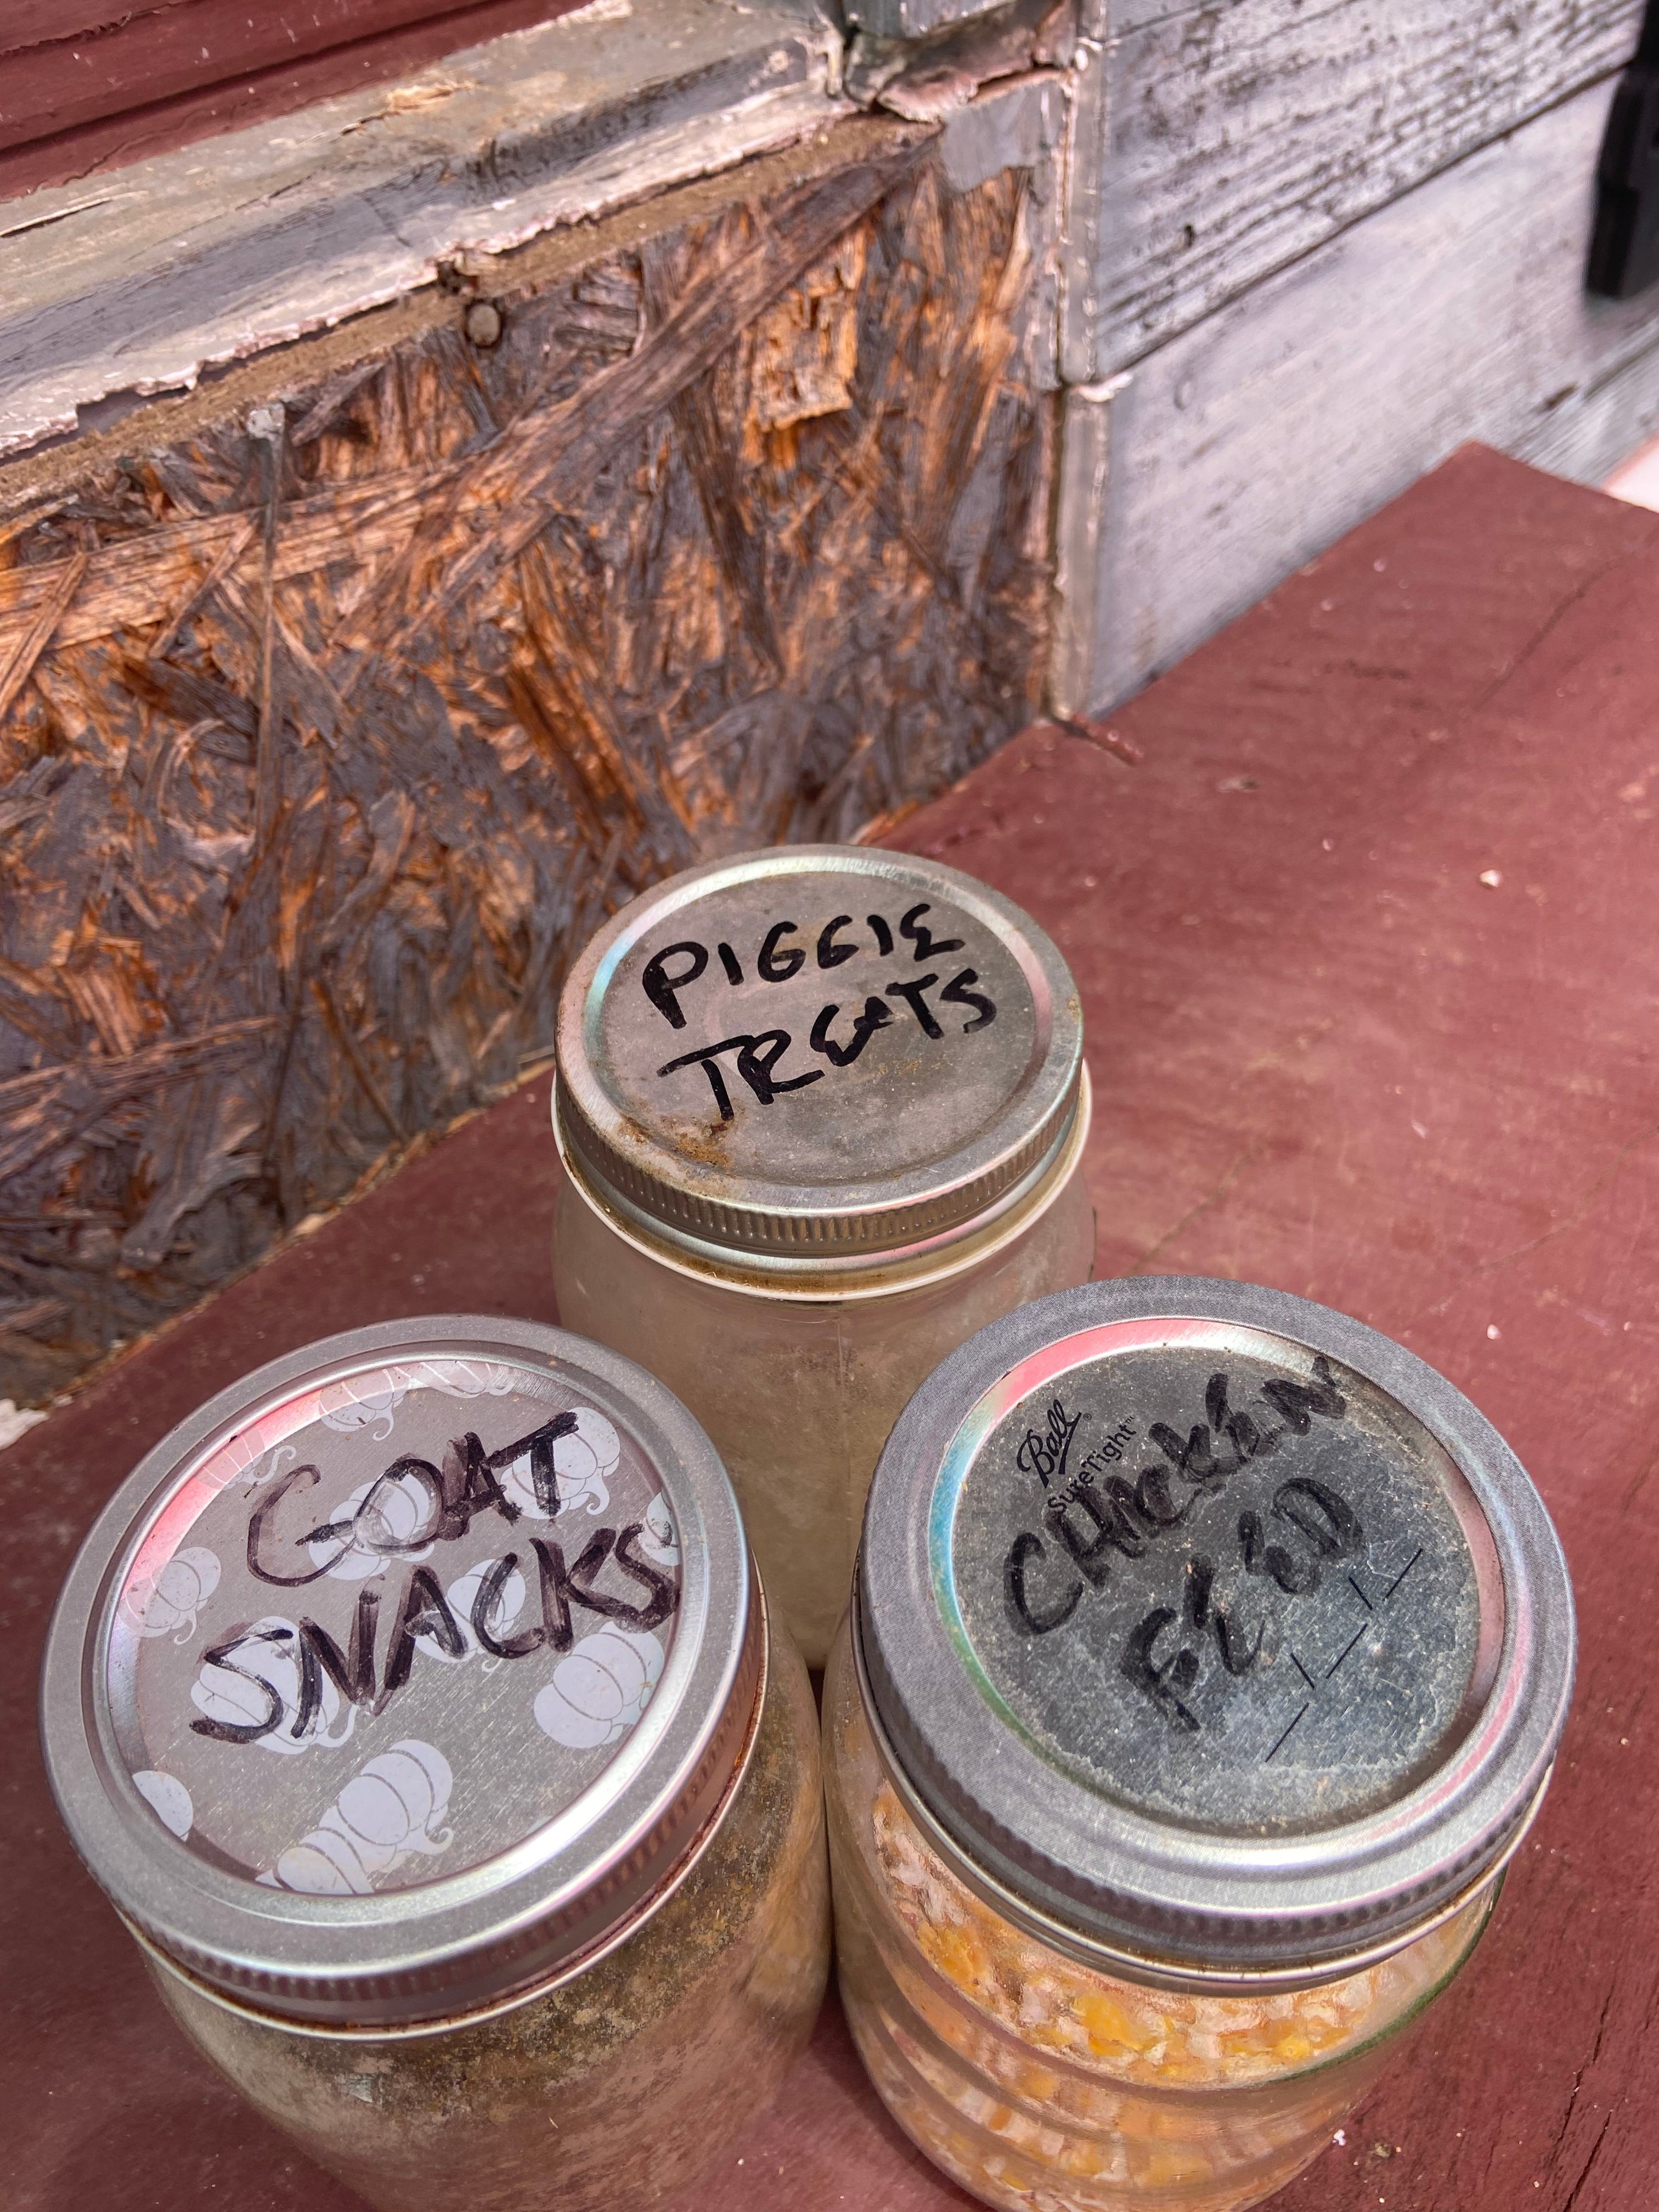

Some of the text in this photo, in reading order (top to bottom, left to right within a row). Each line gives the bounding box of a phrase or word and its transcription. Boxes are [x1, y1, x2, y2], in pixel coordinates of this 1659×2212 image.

[642, 903, 965, 1029] PIGGIE
[657, 968, 997, 1120] TREATS
[246, 1411, 579, 1587] GOAT
[189, 1522, 680, 1743] SNACKS
[1120, 1477, 1365, 1733] FEED
